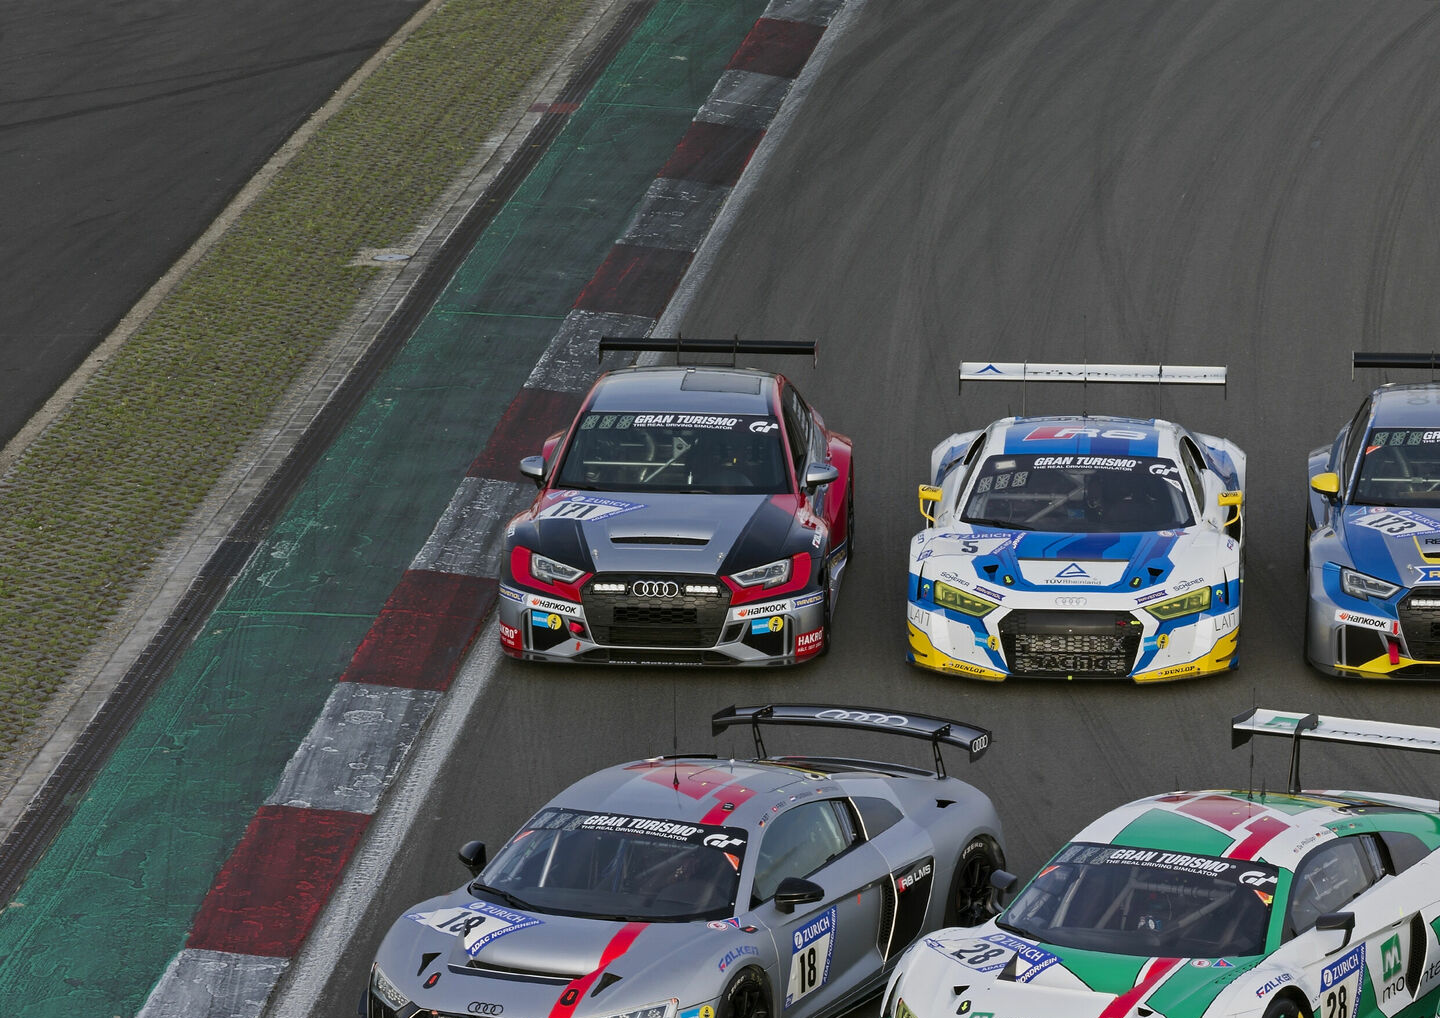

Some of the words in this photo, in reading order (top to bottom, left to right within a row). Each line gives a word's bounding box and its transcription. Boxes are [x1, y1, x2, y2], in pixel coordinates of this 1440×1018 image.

[634, 415, 675, 424] GRAN
[677, 415, 737, 426] TURISMO
[1033, 456, 1072, 467] GRAN
[1076, 456, 1137, 468] TURISMO
[551, 502, 599, 518] 171
[587, 497, 631, 508] ZURICH
[1368, 514, 1417, 534] 173
[961, 532, 1012, 540] ZURICH
[961, 540, 979, 553] 5
[798, 629, 824, 646] HAKRO
[953, 663, 986, 674] DUNLOP
[1163, 665, 1196, 676] DUNLOP
[584, 815, 626, 828] GRAN
[629, 818, 698, 837] TURISMO
[615, 827, 644, 835] DRIVING
[645, 830, 688, 842] SIMULATOR
[1109, 849, 1154, 862] GRAN
[1157, 852, 1230, 873] TURISMO
[1141, 862, 1173, 870] DRIVING
[1173, 864, 1218, 877] SIMULATOR
[913, 864, 931, 885] LMS
[483, 904, 526, 924] ZURICH
[436, 911, 486, 938] 18
[802, 916, 830, 942] ZURICH
[471, 936, 491, 955] ADAC
[491, 919, 540, 940] NORDRHEIN
[718, 945, 759, 973] FALKEN
[951, 943, 1005, 965] 28
[1002, 937, 1043, 962] ZURICH
[799, 947, 817, 994] 18
[1332, 953, 1359, 978] ZURICH
[1255, 972, 1294, 999] FALKEN
